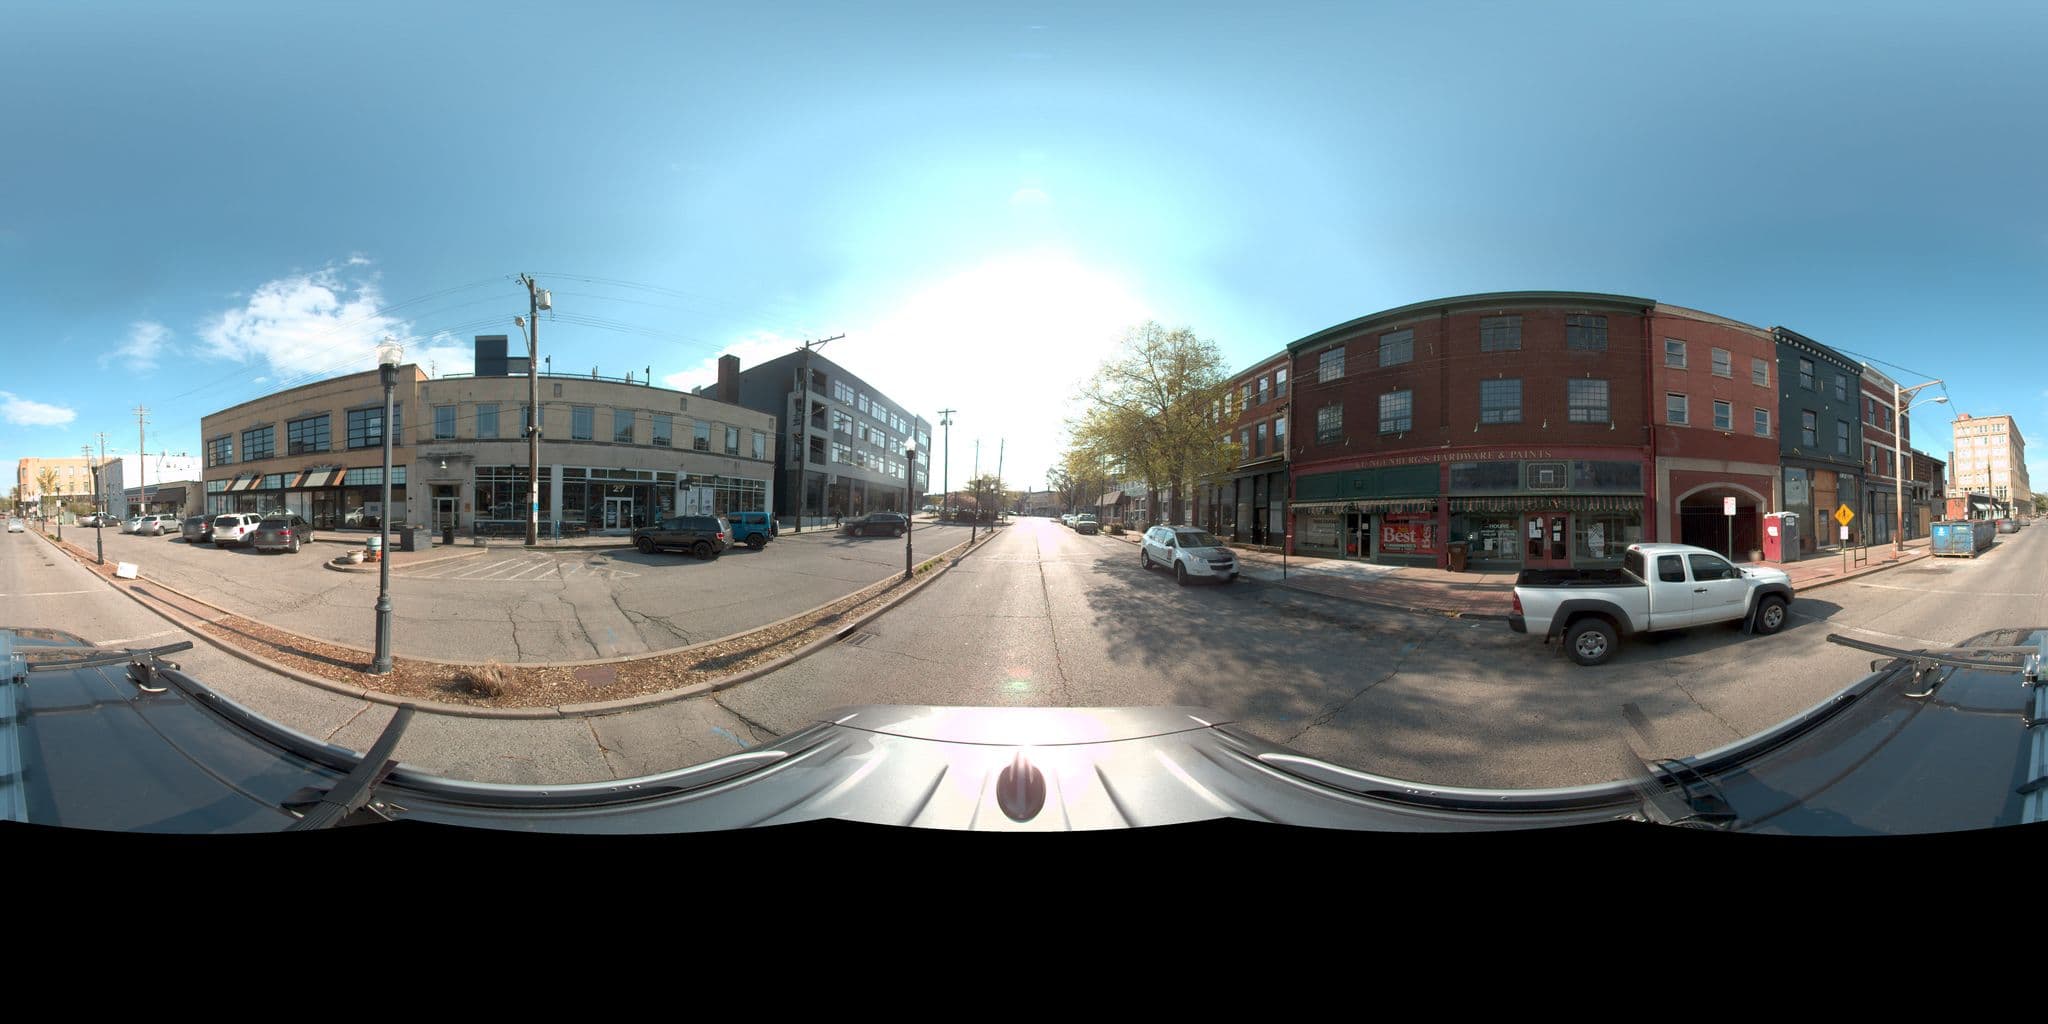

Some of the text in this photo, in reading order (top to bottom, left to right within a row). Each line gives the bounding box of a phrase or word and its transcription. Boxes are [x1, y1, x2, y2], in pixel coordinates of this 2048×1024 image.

[1433, 452, 1492, 462] HARDWARE
[1498, 451, 1505, 459] &
[1511, 449, 1552, 459] PAINTS
[612, 484, 625, 492] 27
[1384, 527, 1416, 543] Best
